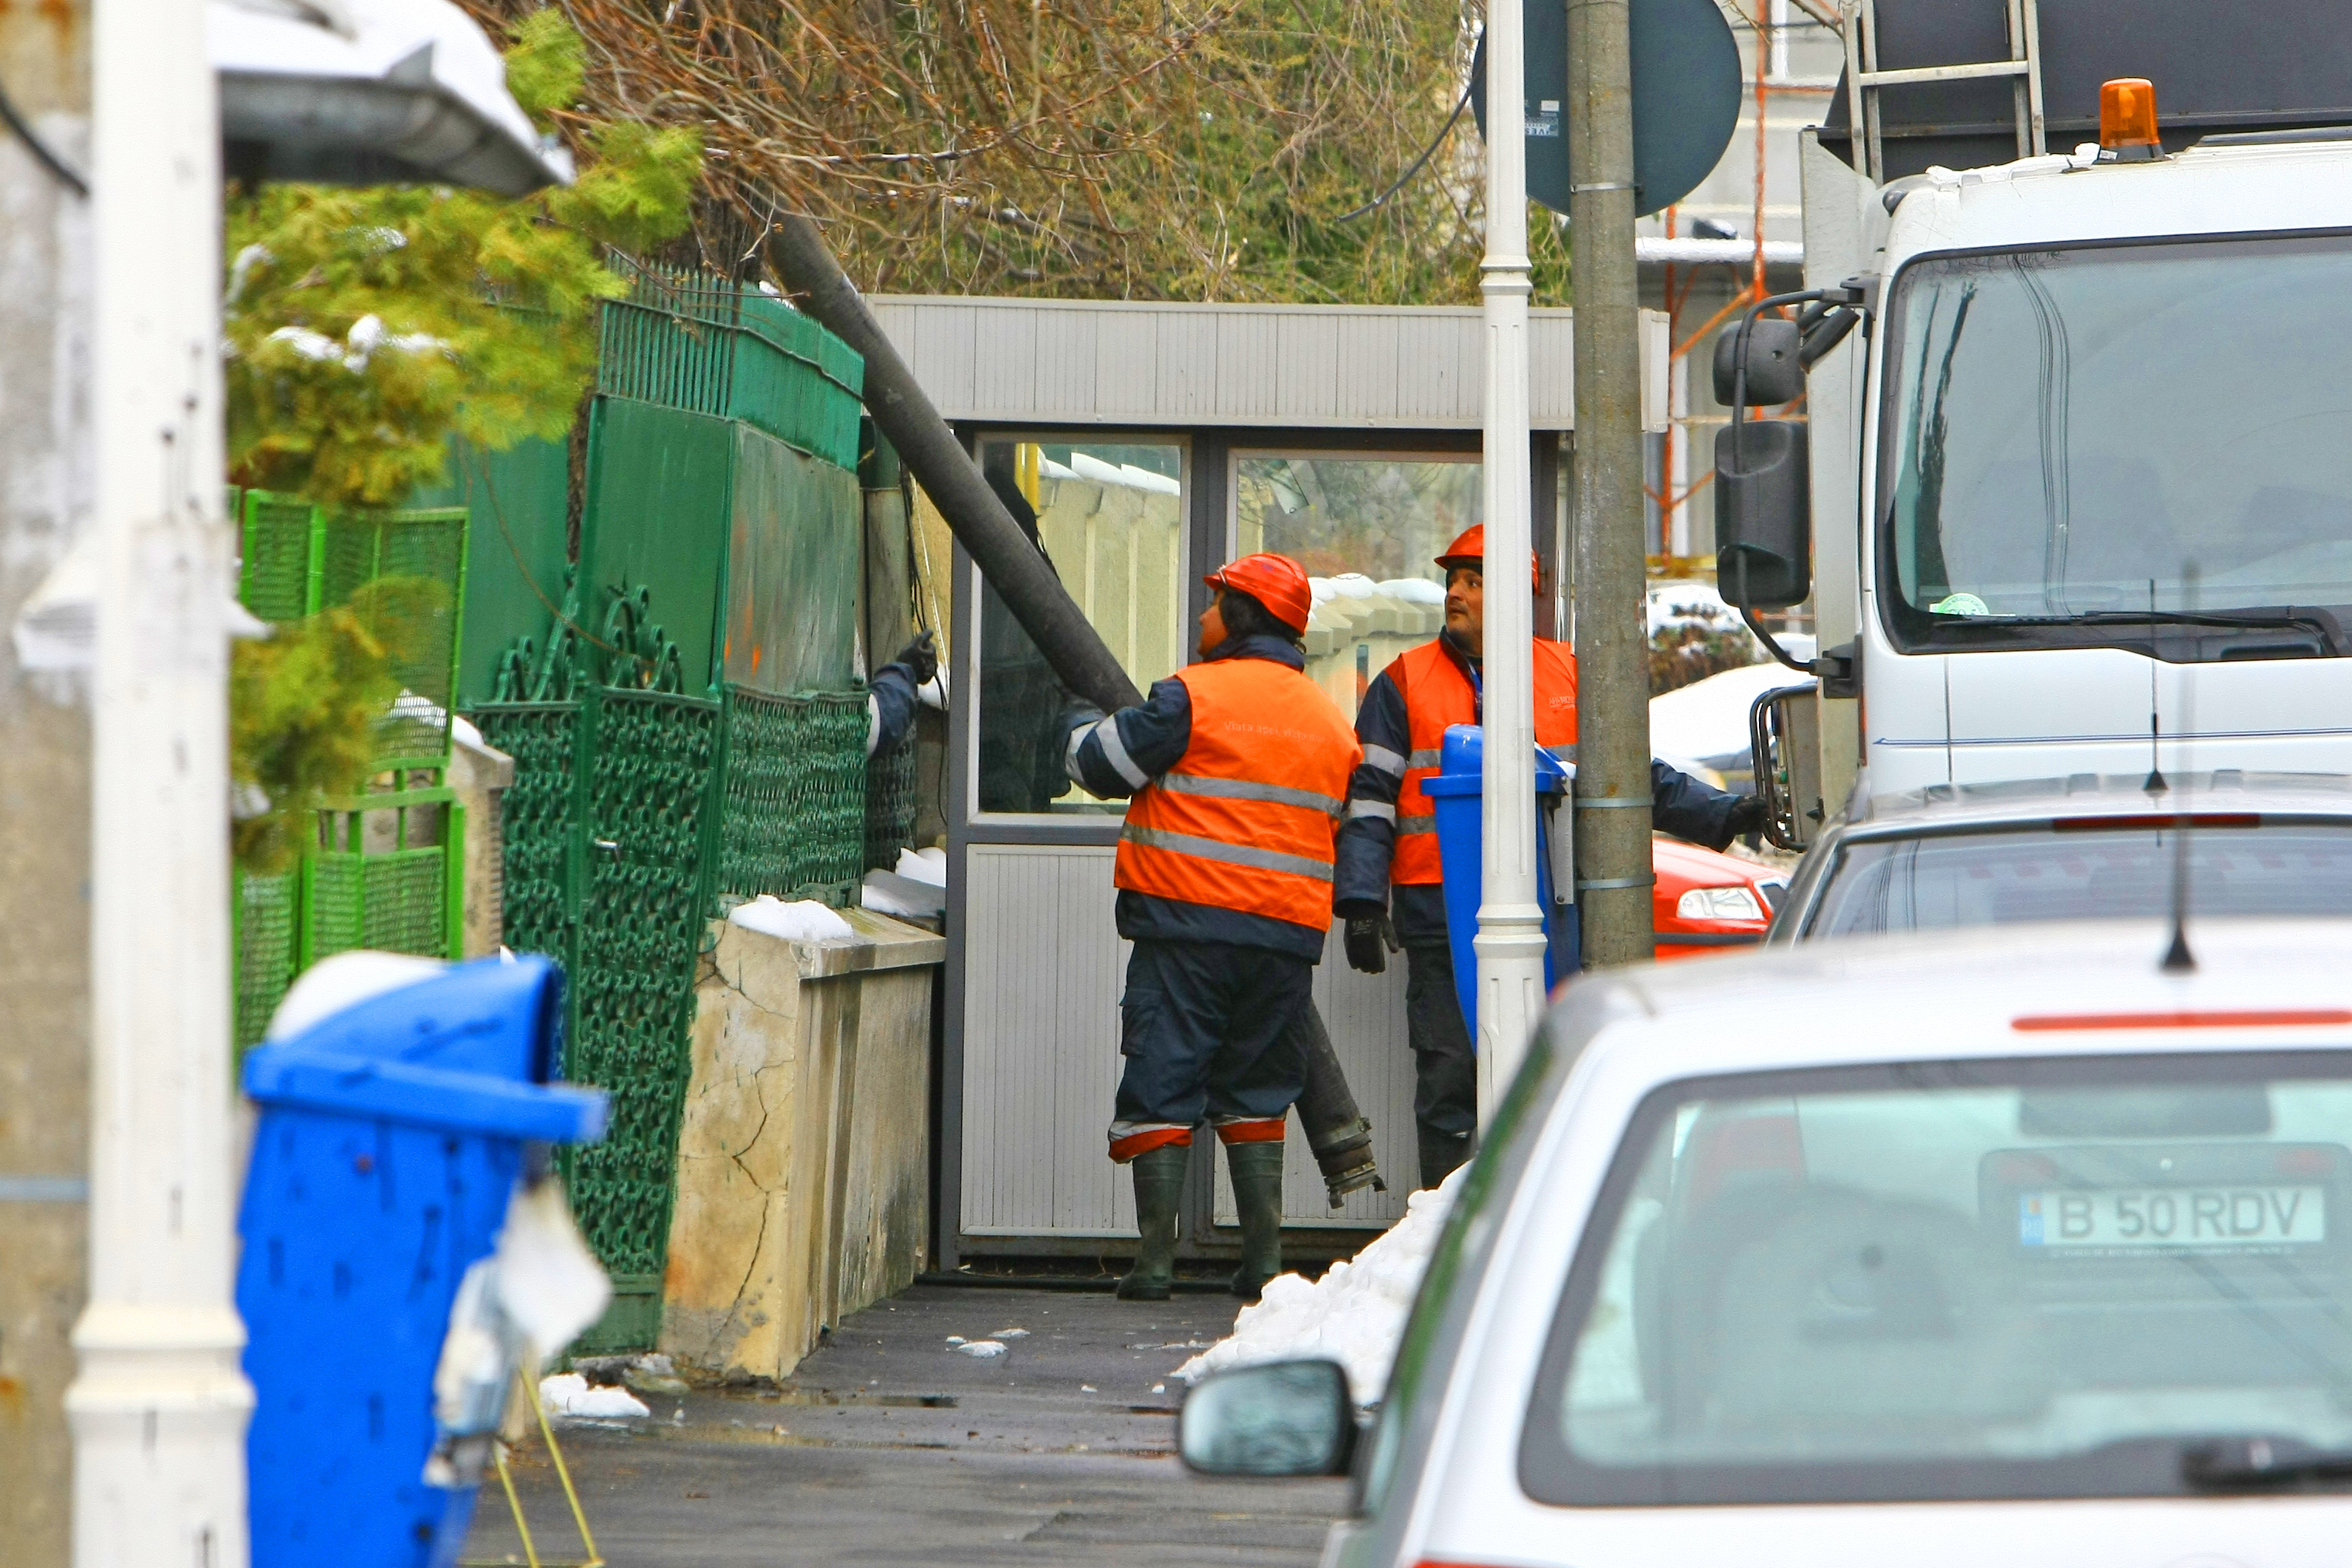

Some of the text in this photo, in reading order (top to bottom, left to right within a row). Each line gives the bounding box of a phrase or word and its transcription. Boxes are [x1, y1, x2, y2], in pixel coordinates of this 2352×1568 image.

[2059, 1195, 2093, 1237] B
[2117, 1194, 2176, 1237] 50
[2192, 1191, 2300, 1237] RDV
